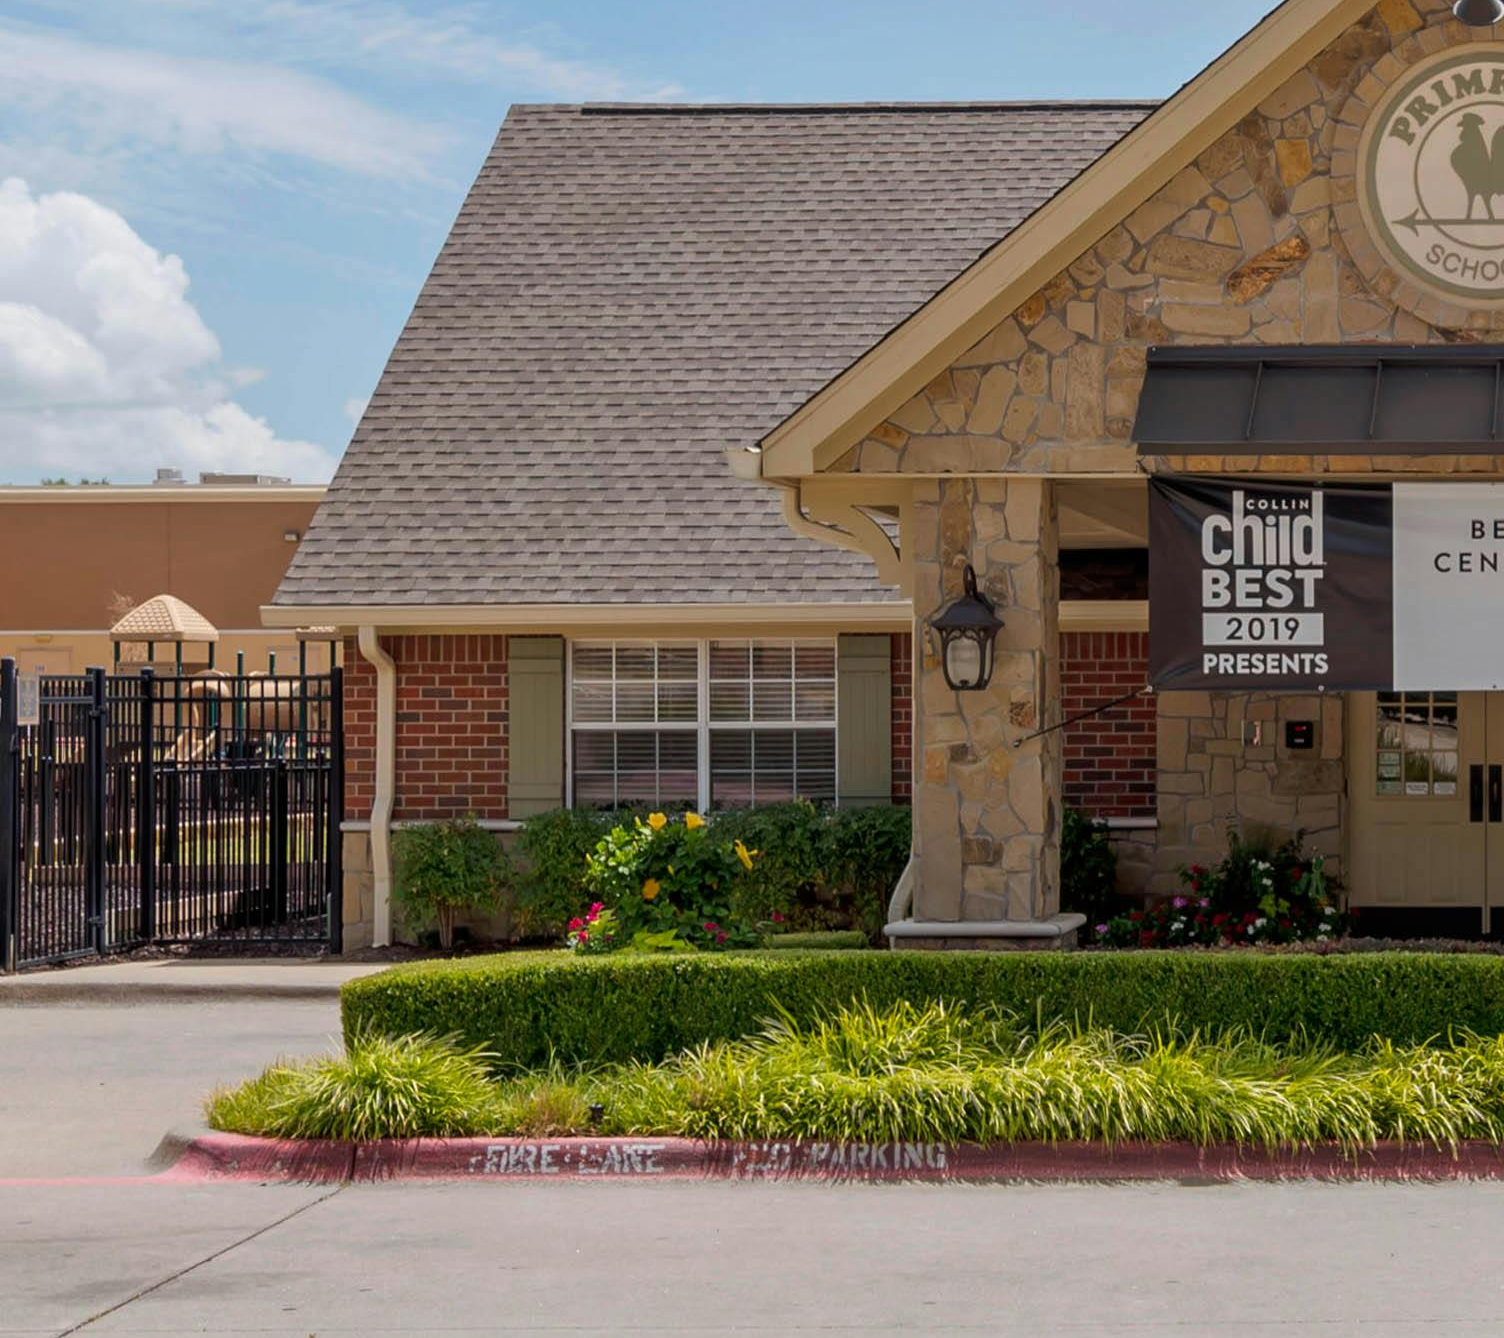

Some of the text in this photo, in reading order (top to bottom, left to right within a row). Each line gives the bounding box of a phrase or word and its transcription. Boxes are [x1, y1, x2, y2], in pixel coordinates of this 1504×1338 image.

[1246, 499, 1309, 510] COLLIN
[1202, 490, 1324, 566] child
[1202, 569, 1324, 608] BEST
[1226, 617, 1300, 641] 2019
[1203, 653, 1328, 674] PRESENTS
[810, 1142, 946, 1170] PARKING
